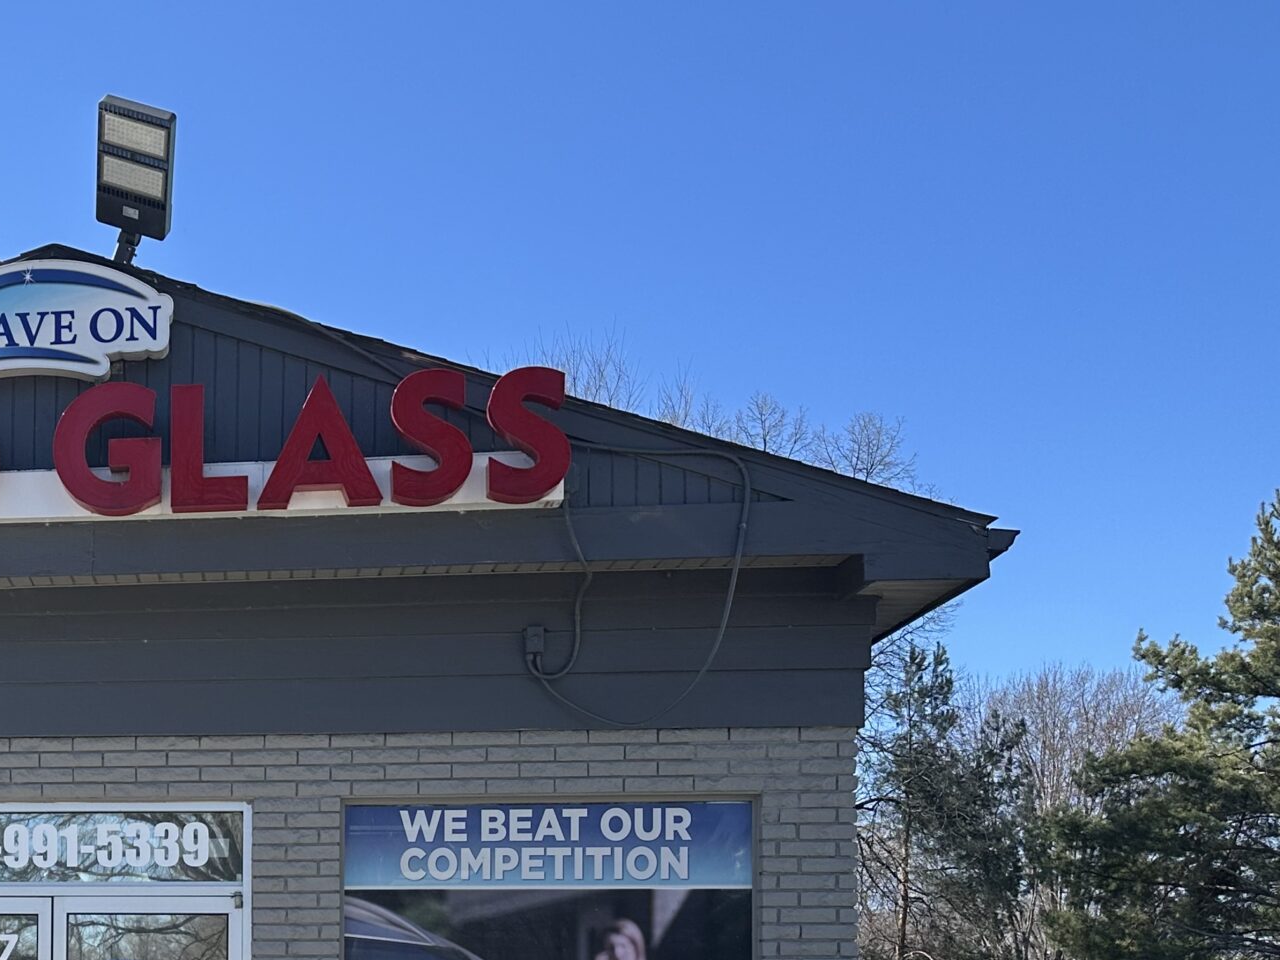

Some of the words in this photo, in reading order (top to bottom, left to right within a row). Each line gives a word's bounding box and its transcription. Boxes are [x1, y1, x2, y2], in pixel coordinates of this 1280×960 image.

[88, 304, 164, 348] ON
[52, 367, 571, 517] GLASS
[400, 809, 468, 842] WE
[480, 807, 588, 842] BEAT
[600, 806, 693, 841] OUR
[400, 846, 690, 881] COMPETITION
